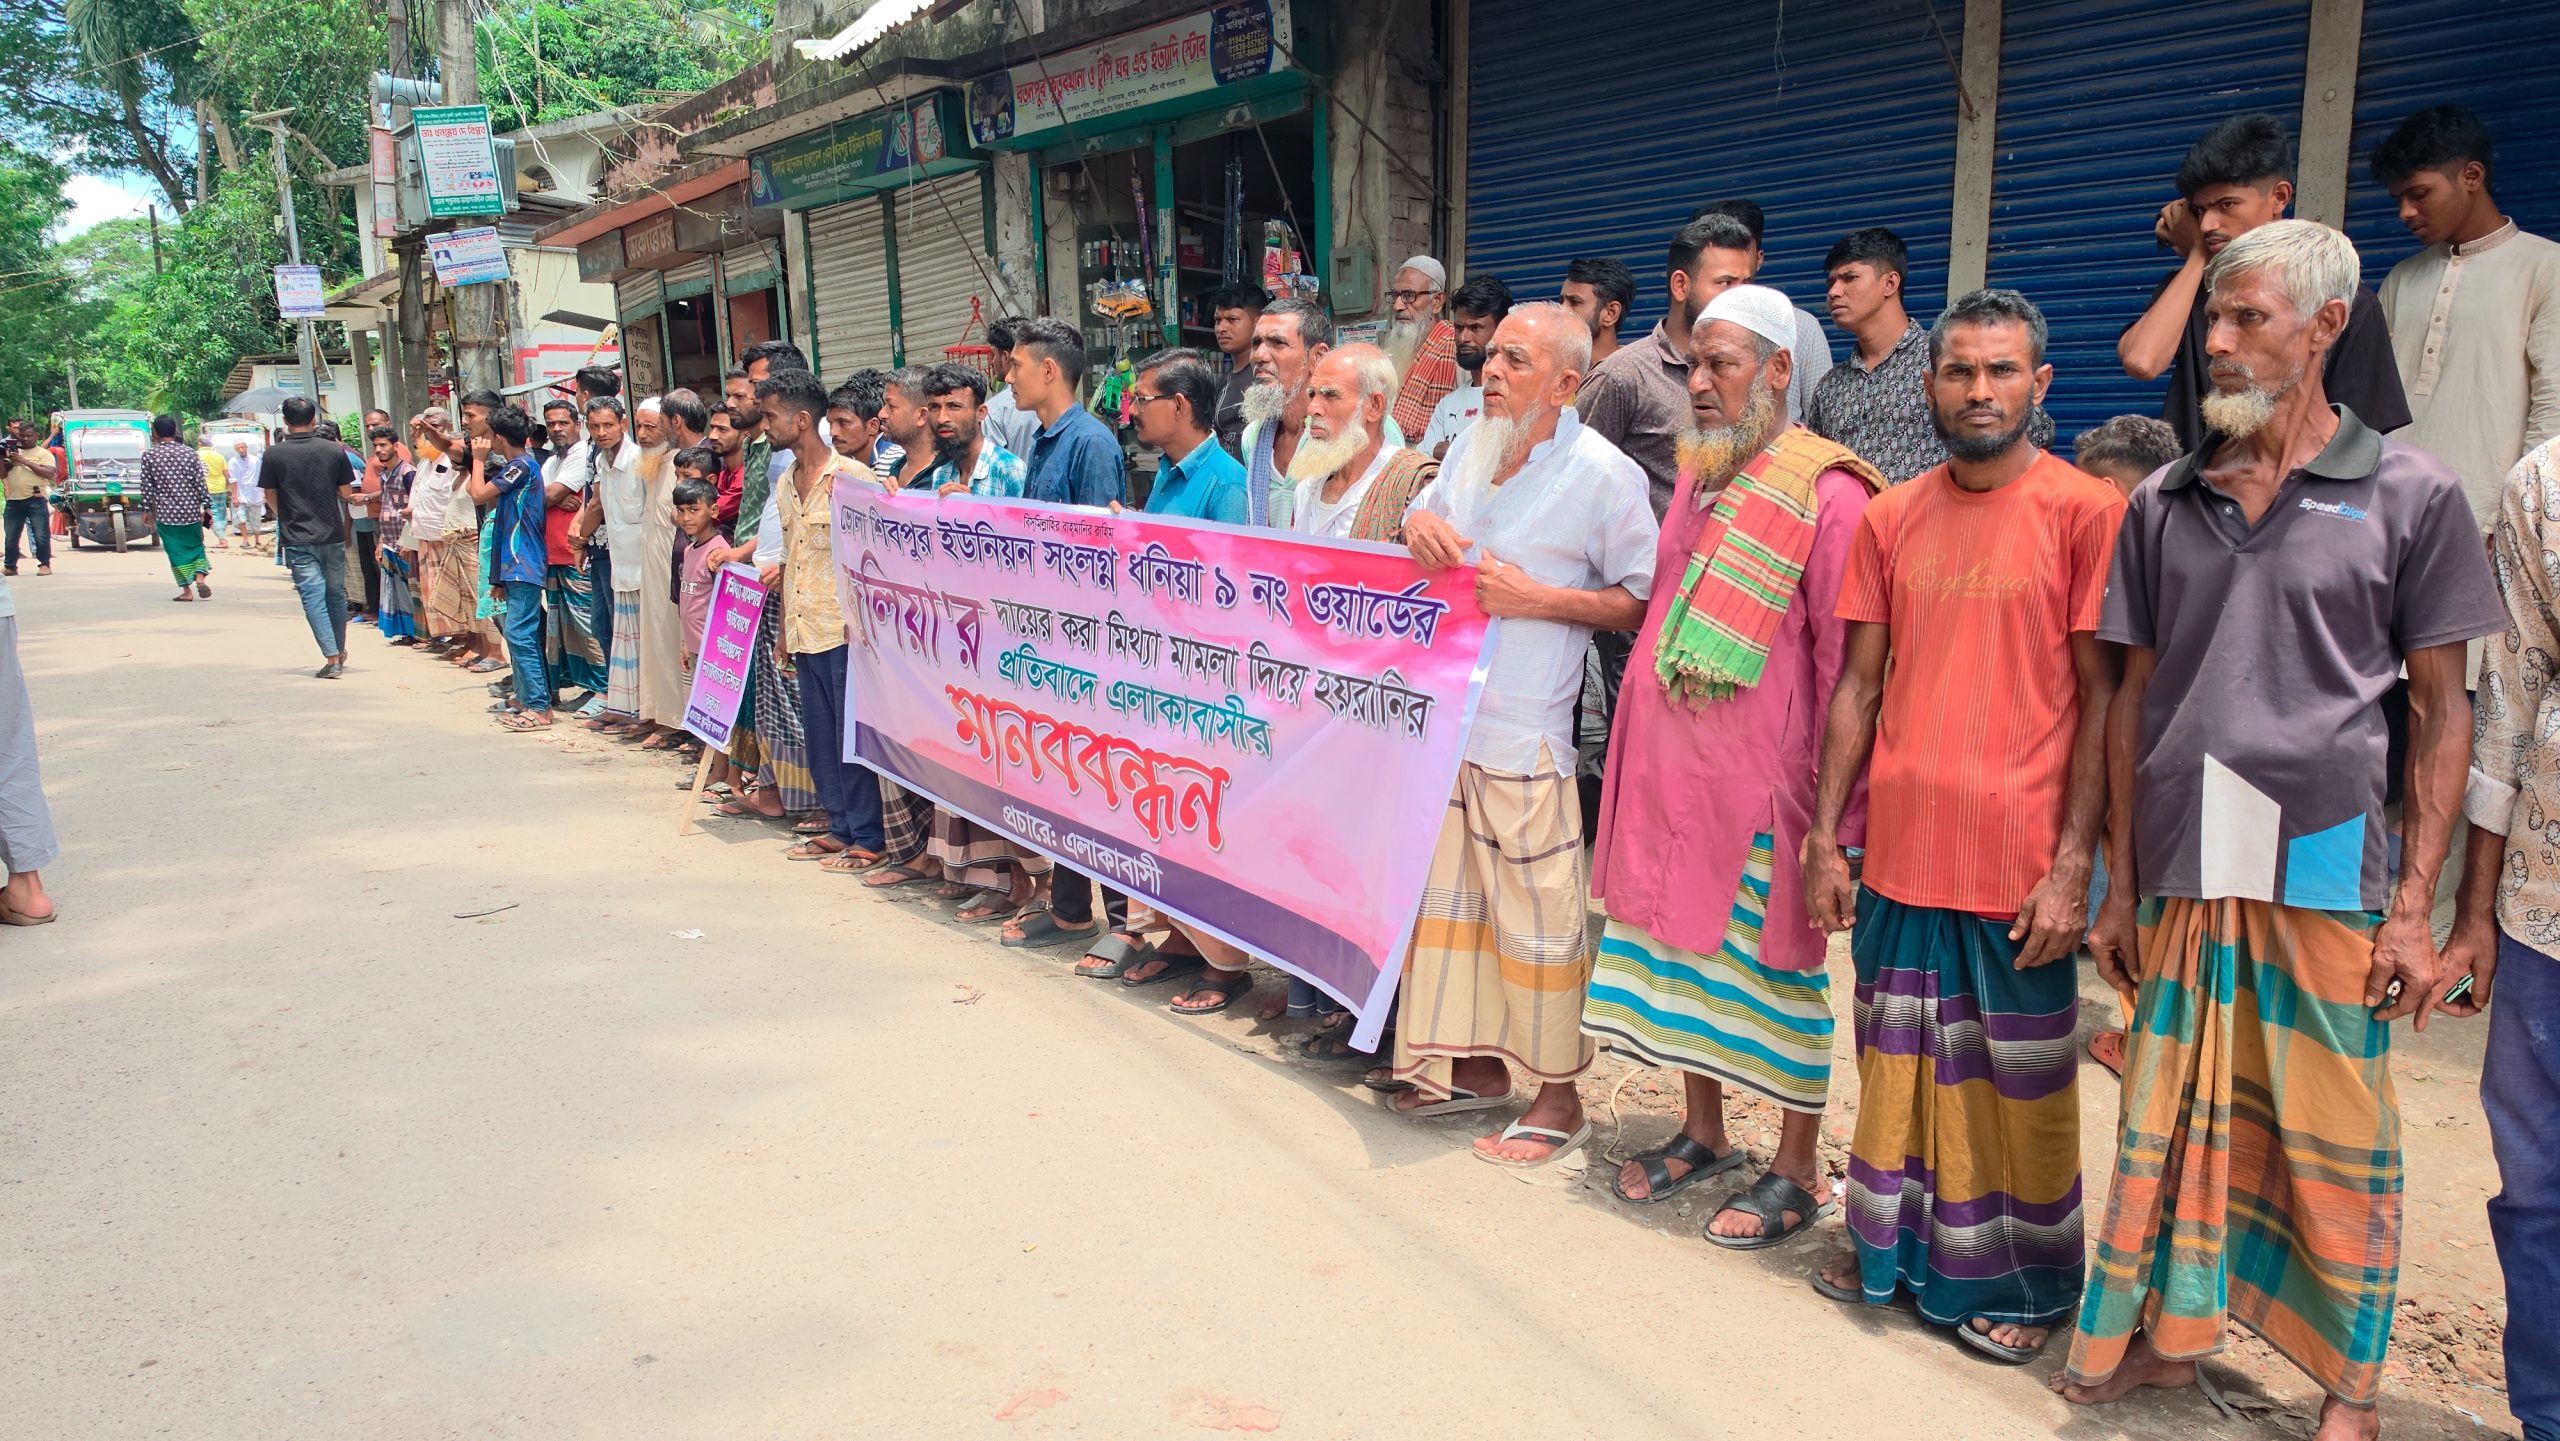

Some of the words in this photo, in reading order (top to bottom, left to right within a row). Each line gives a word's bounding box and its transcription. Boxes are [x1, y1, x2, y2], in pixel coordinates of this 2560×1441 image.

[869, 510, 933, 564] শিবপুর
[936, 515, 1036, 574] ইউনিয়ন
[1042, 539, 1119, 593] সংলগ্ন
[1127, 540, 1205, 606] ধনিয়া
[1213, 566, 1238, 609] ৯
[1248, 570, 1292, 627] নং
[1302, 579, 1450, 649] ওয়ার্ডের
[991, 597, 1054, 645] দায়ের
[1058, 610, 1101, 653] করা
[1105, 608, 1163, 669] মিথ্যা
[1168, 633, 1240, 692] মামলা
[1246, 640, 1313, 709] দিয়ে
[1313, 665, 1438, 742] হয়রানির
[998, 650, 1100, 708] প্রতিবাদে
[1106, 680, 1275, 760] এলাকাবাসীর
[944, 683, 1232, 851] মানববন্ধন
[1063, 831, 1163, 896] এলাকাবাসী
